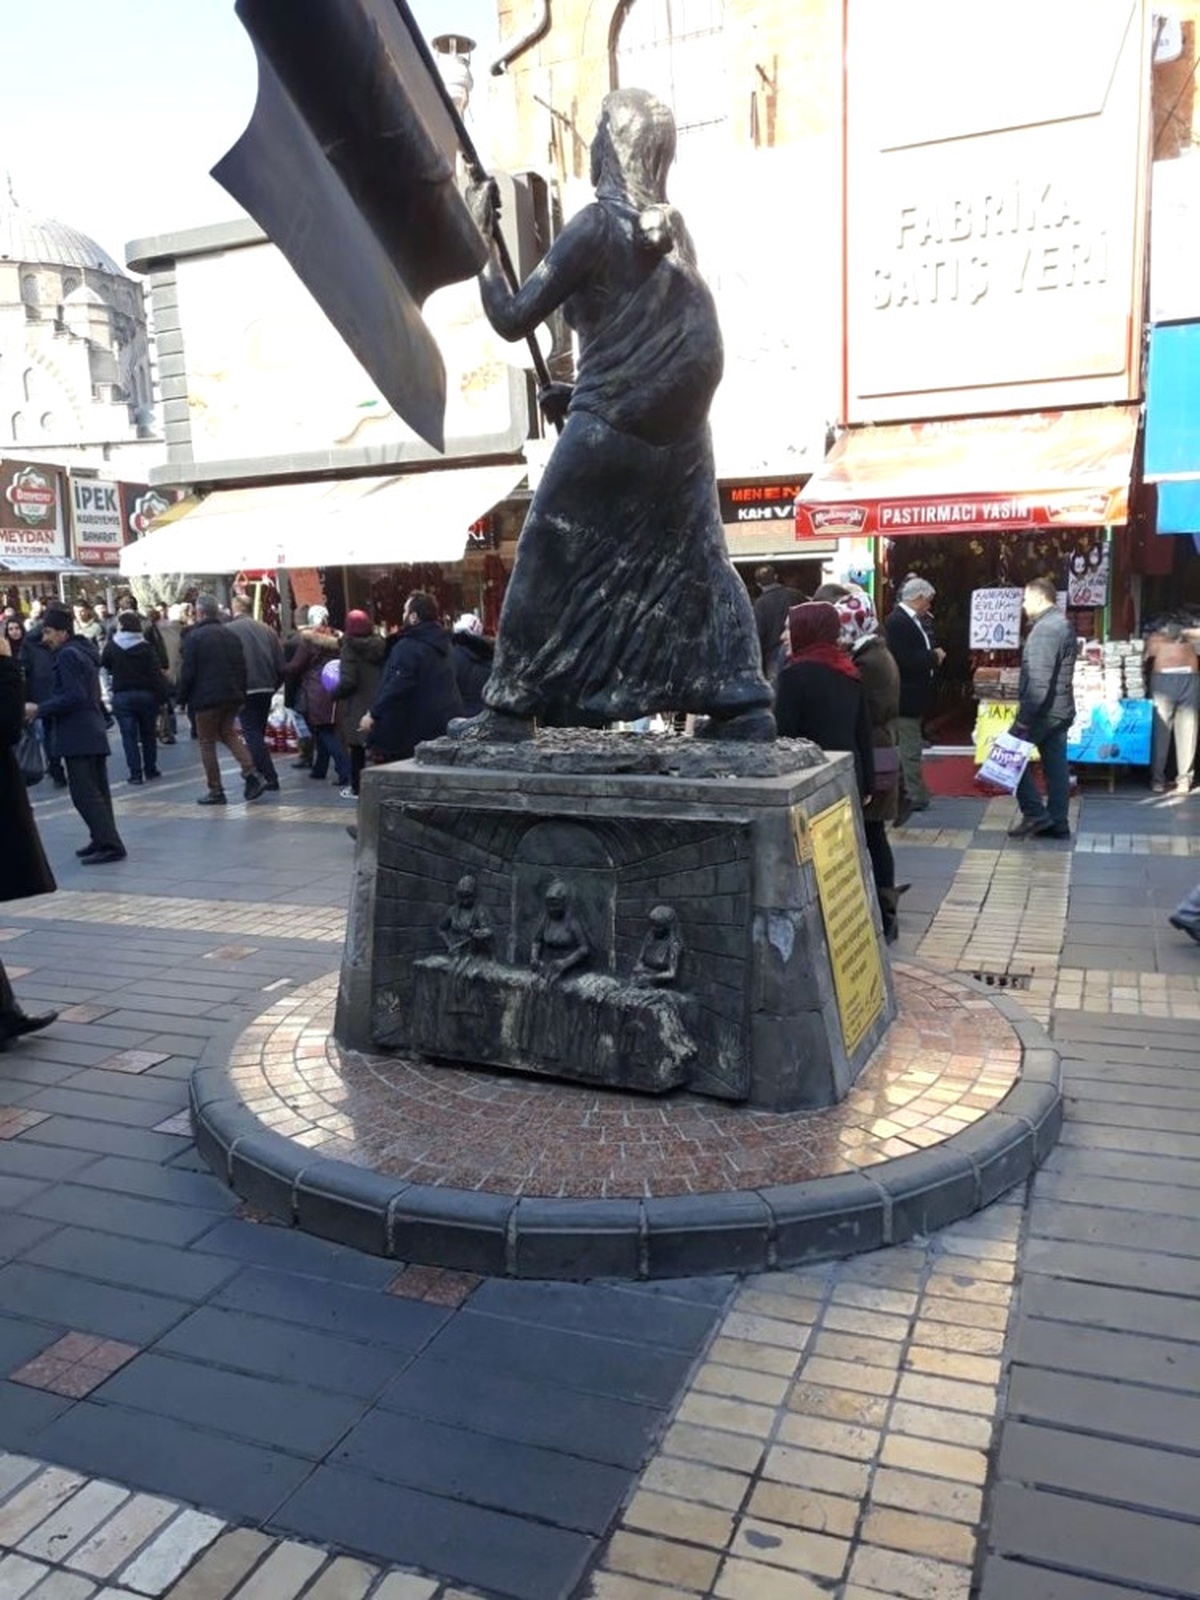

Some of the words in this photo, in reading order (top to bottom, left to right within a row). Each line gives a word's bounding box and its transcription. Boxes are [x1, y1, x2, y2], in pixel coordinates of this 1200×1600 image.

[895, 180, 1081, 250] FABRİKA
[872, 256, 990, 311] SATIŞ
[1011, 229, 1108, 294] YERİ
[74, 480, 118, 512] İPEK
[882, 502, 976, 525] PASTIRMACI
[981, 497, 1030, 520] YASİN
